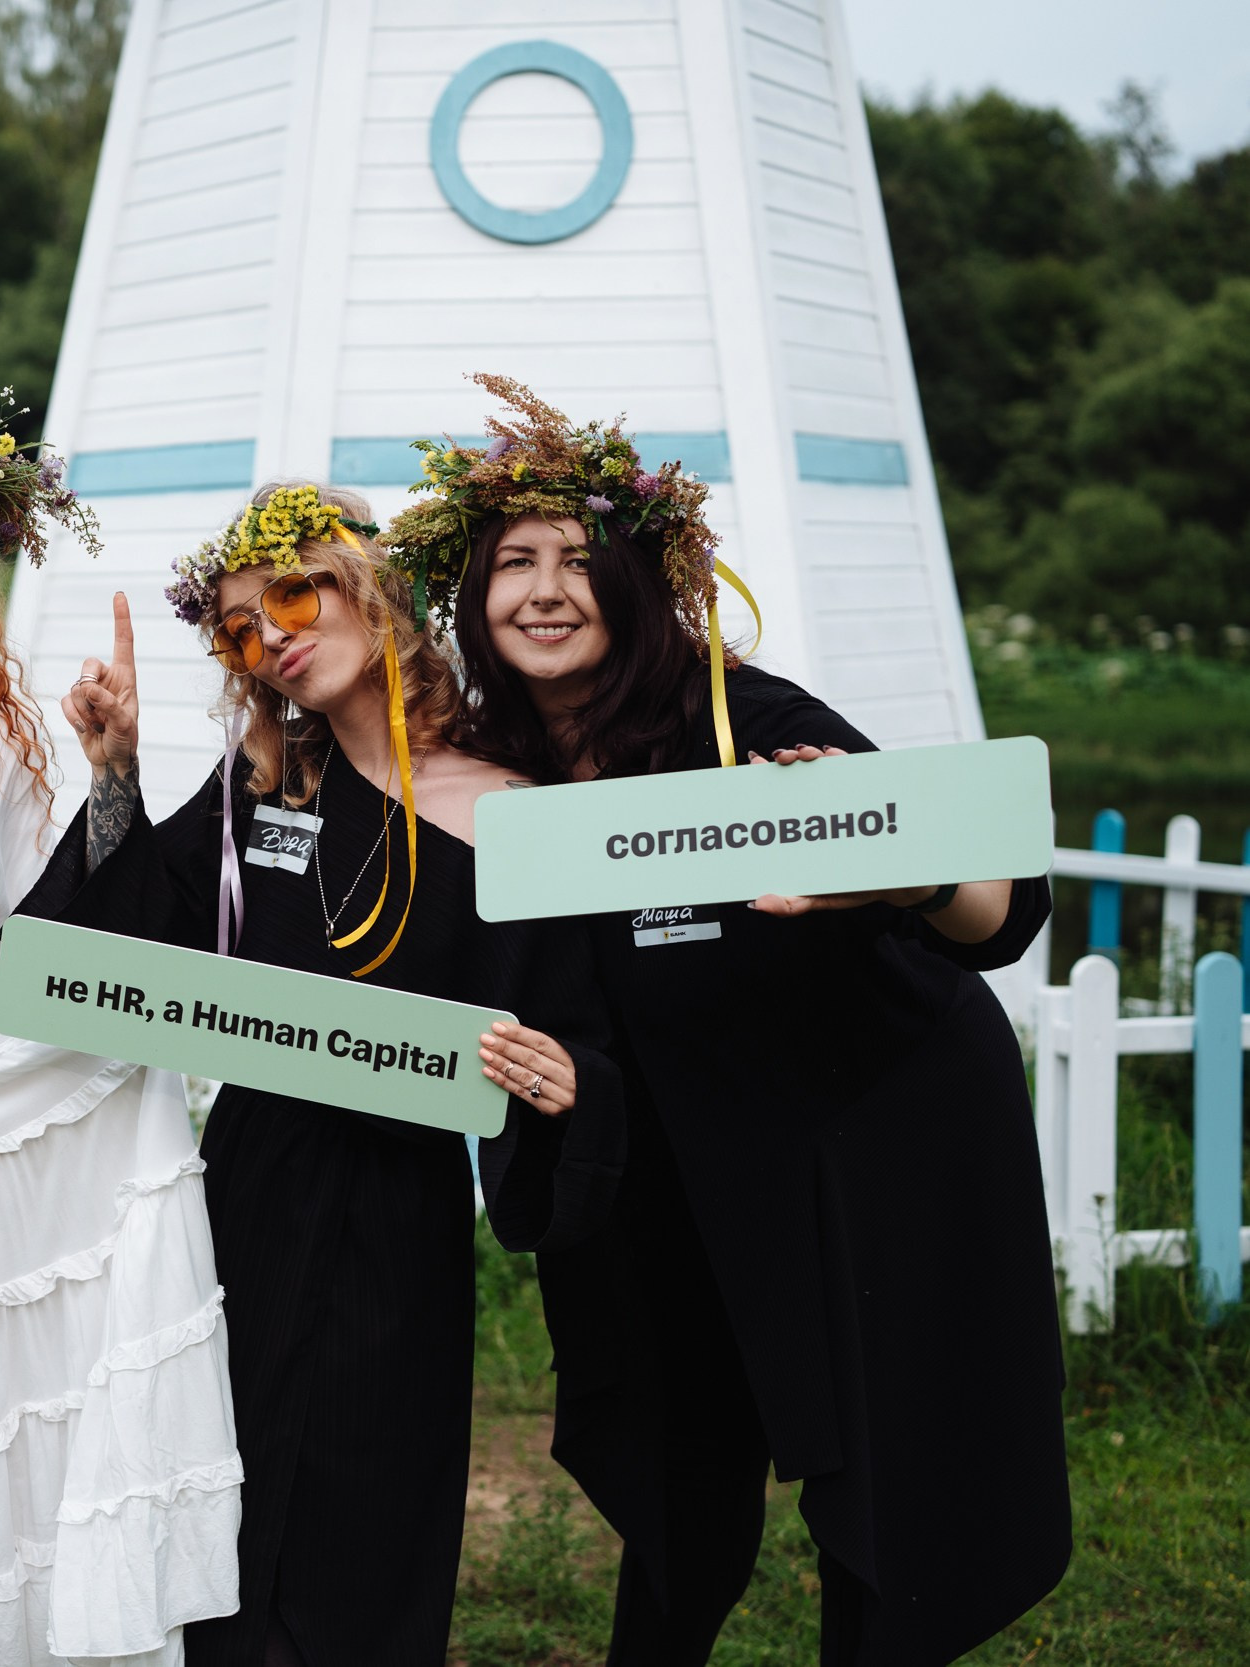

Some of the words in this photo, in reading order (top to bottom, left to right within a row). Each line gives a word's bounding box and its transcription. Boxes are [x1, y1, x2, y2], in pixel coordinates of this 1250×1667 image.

[606, 802, 898, 860] согласовано!
[632, 907, 693, 928] Маша
[46, 975, 88, 1004] не
[96, 980, 155, 1023] HR,
[191, 1000, 319, 1052] Human
[327, 1028, 459, 1081] Capital
